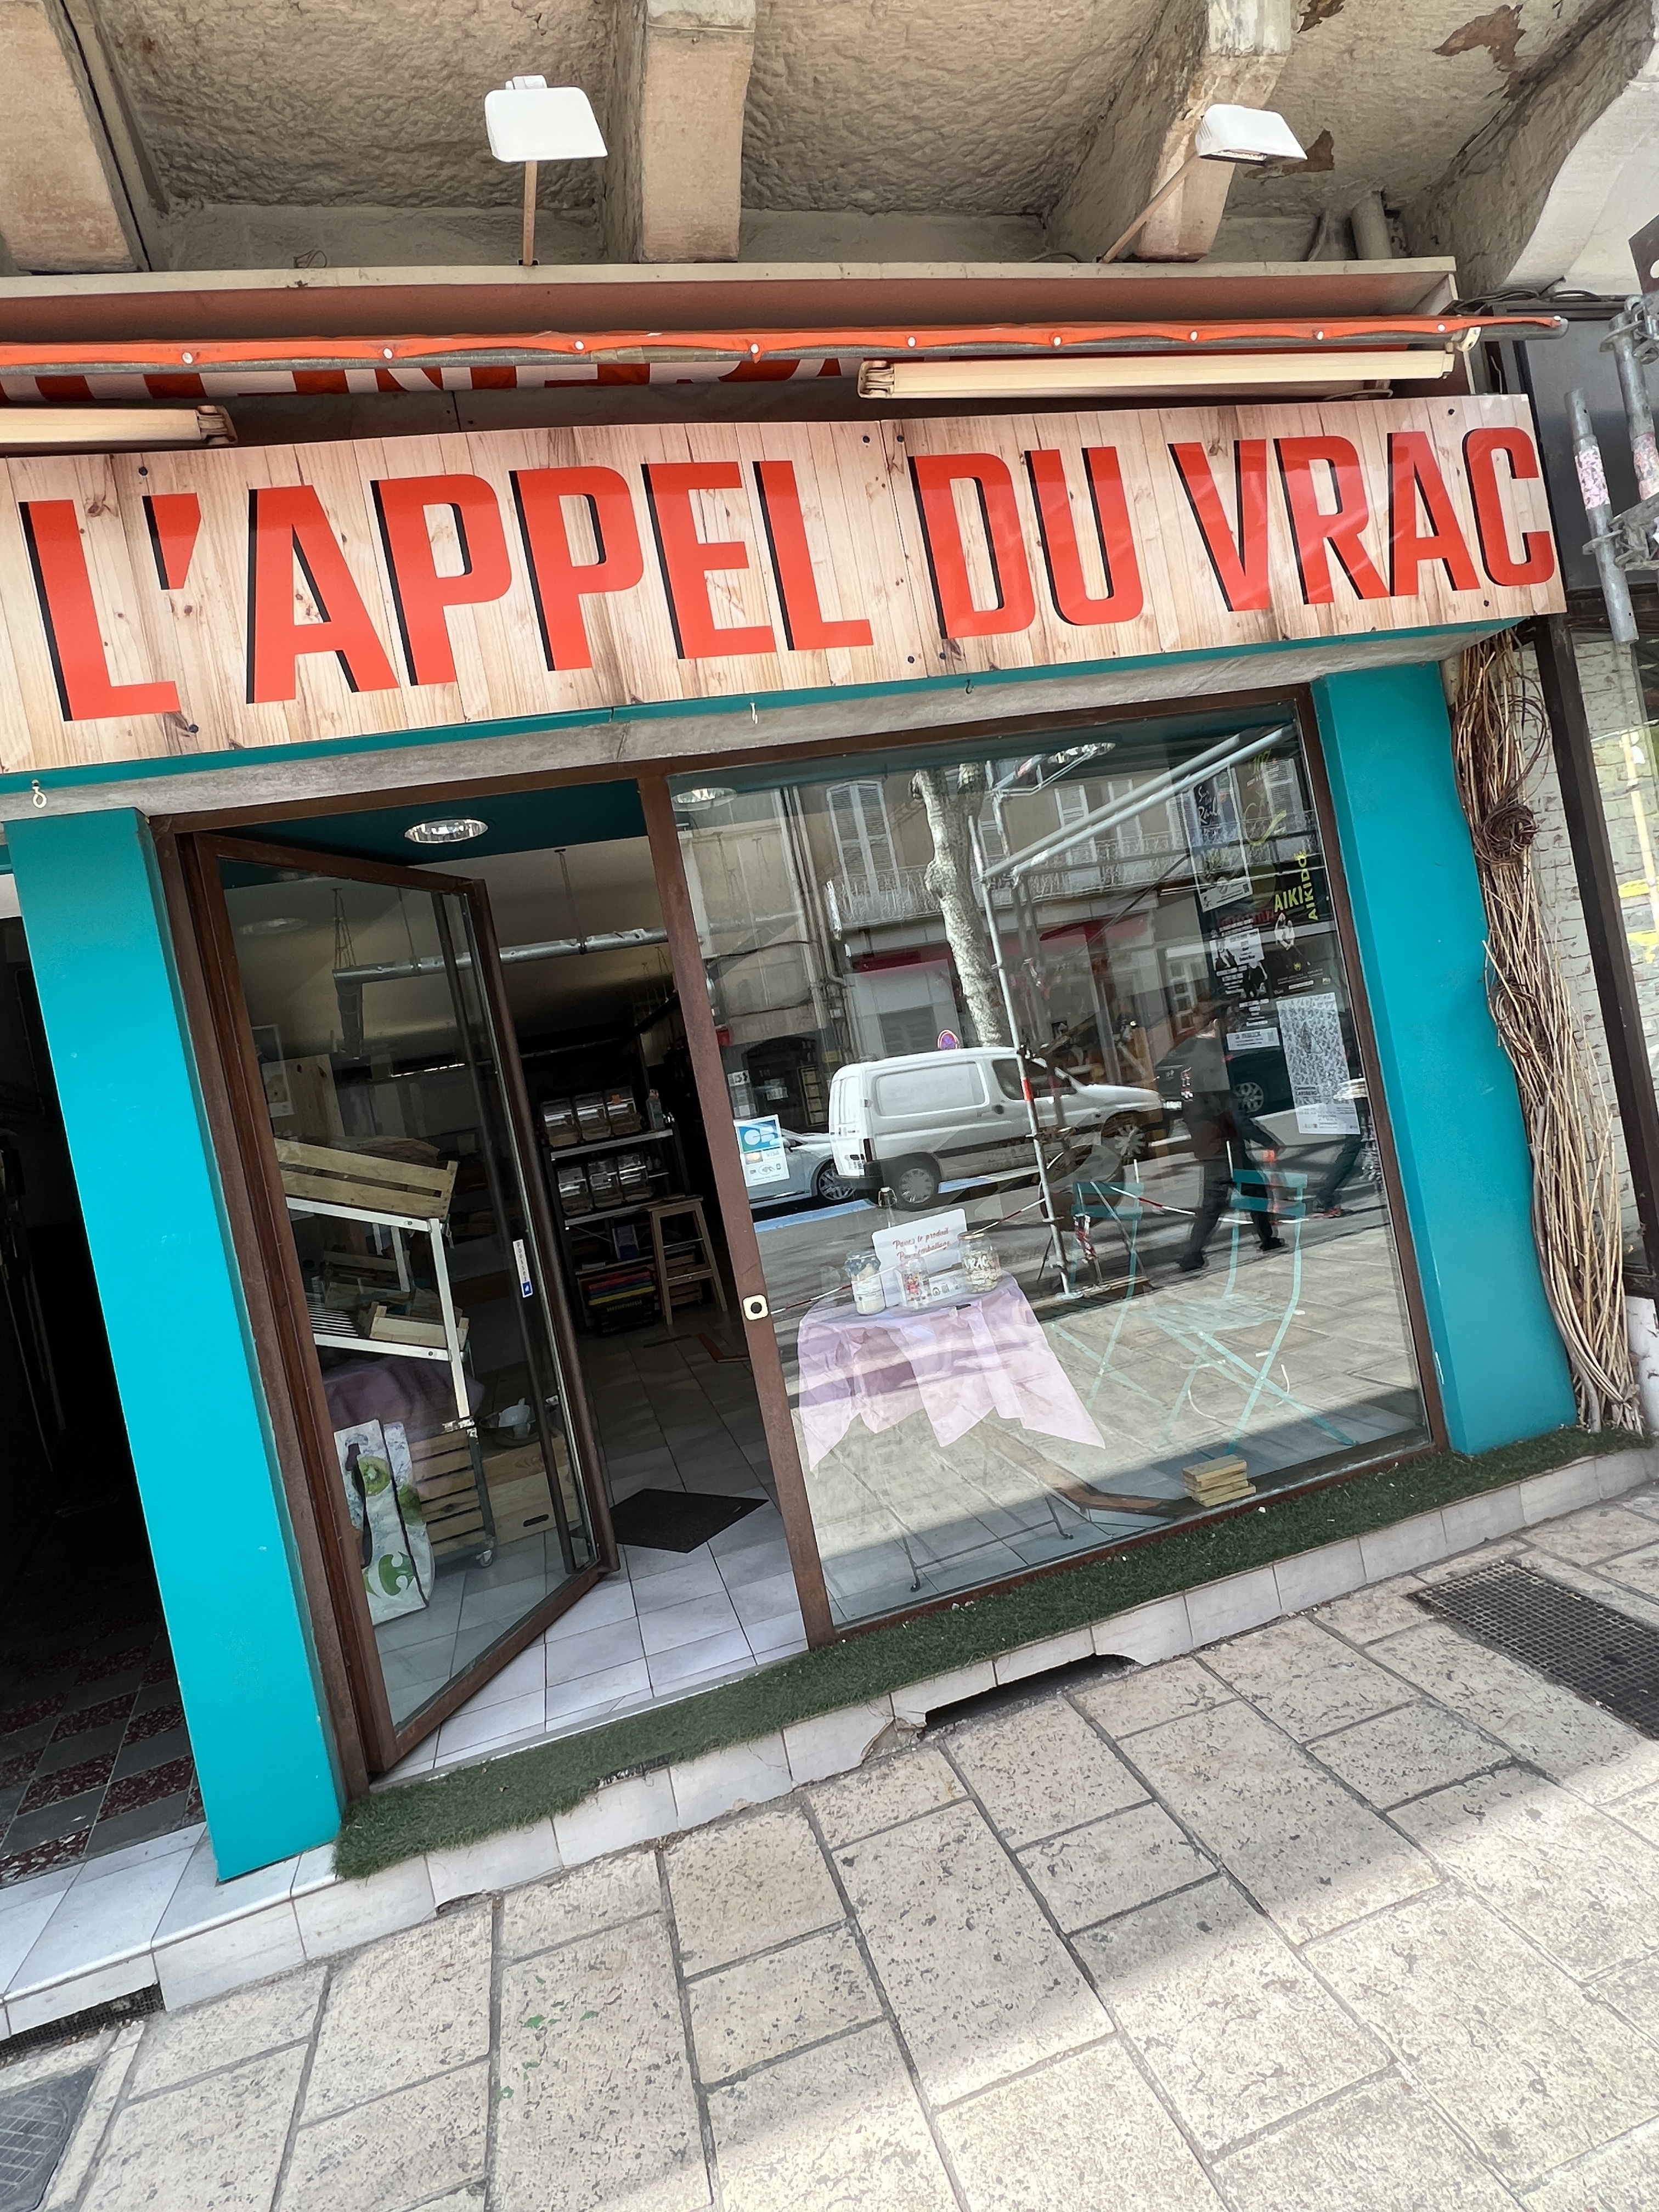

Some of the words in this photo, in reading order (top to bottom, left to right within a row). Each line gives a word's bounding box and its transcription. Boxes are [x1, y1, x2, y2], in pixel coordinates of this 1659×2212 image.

[18, 460, 874, 722] L'APPEL
[907, 446, 1143, 640] DU
[1167, 426, 1555, 613] VRAC
